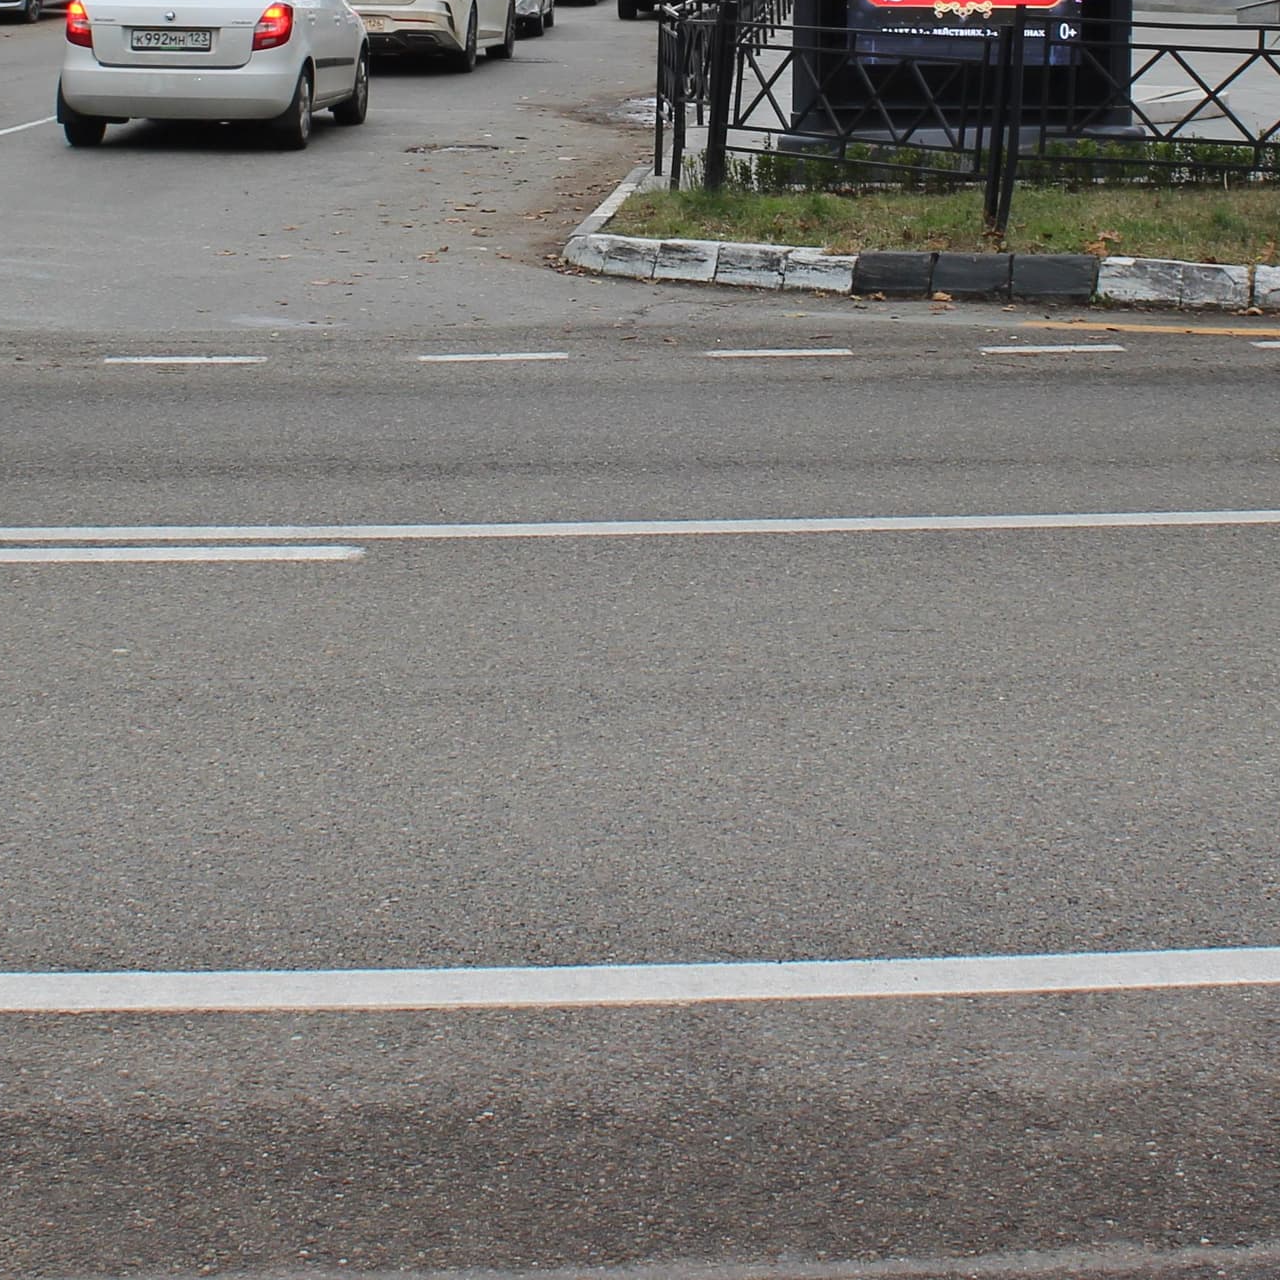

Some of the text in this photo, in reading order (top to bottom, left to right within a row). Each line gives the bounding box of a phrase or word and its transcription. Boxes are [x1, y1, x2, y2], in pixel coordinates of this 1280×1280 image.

[1060, 23, 1077, 39] 0+
[135, 33, 208, 46] К992МН 123
